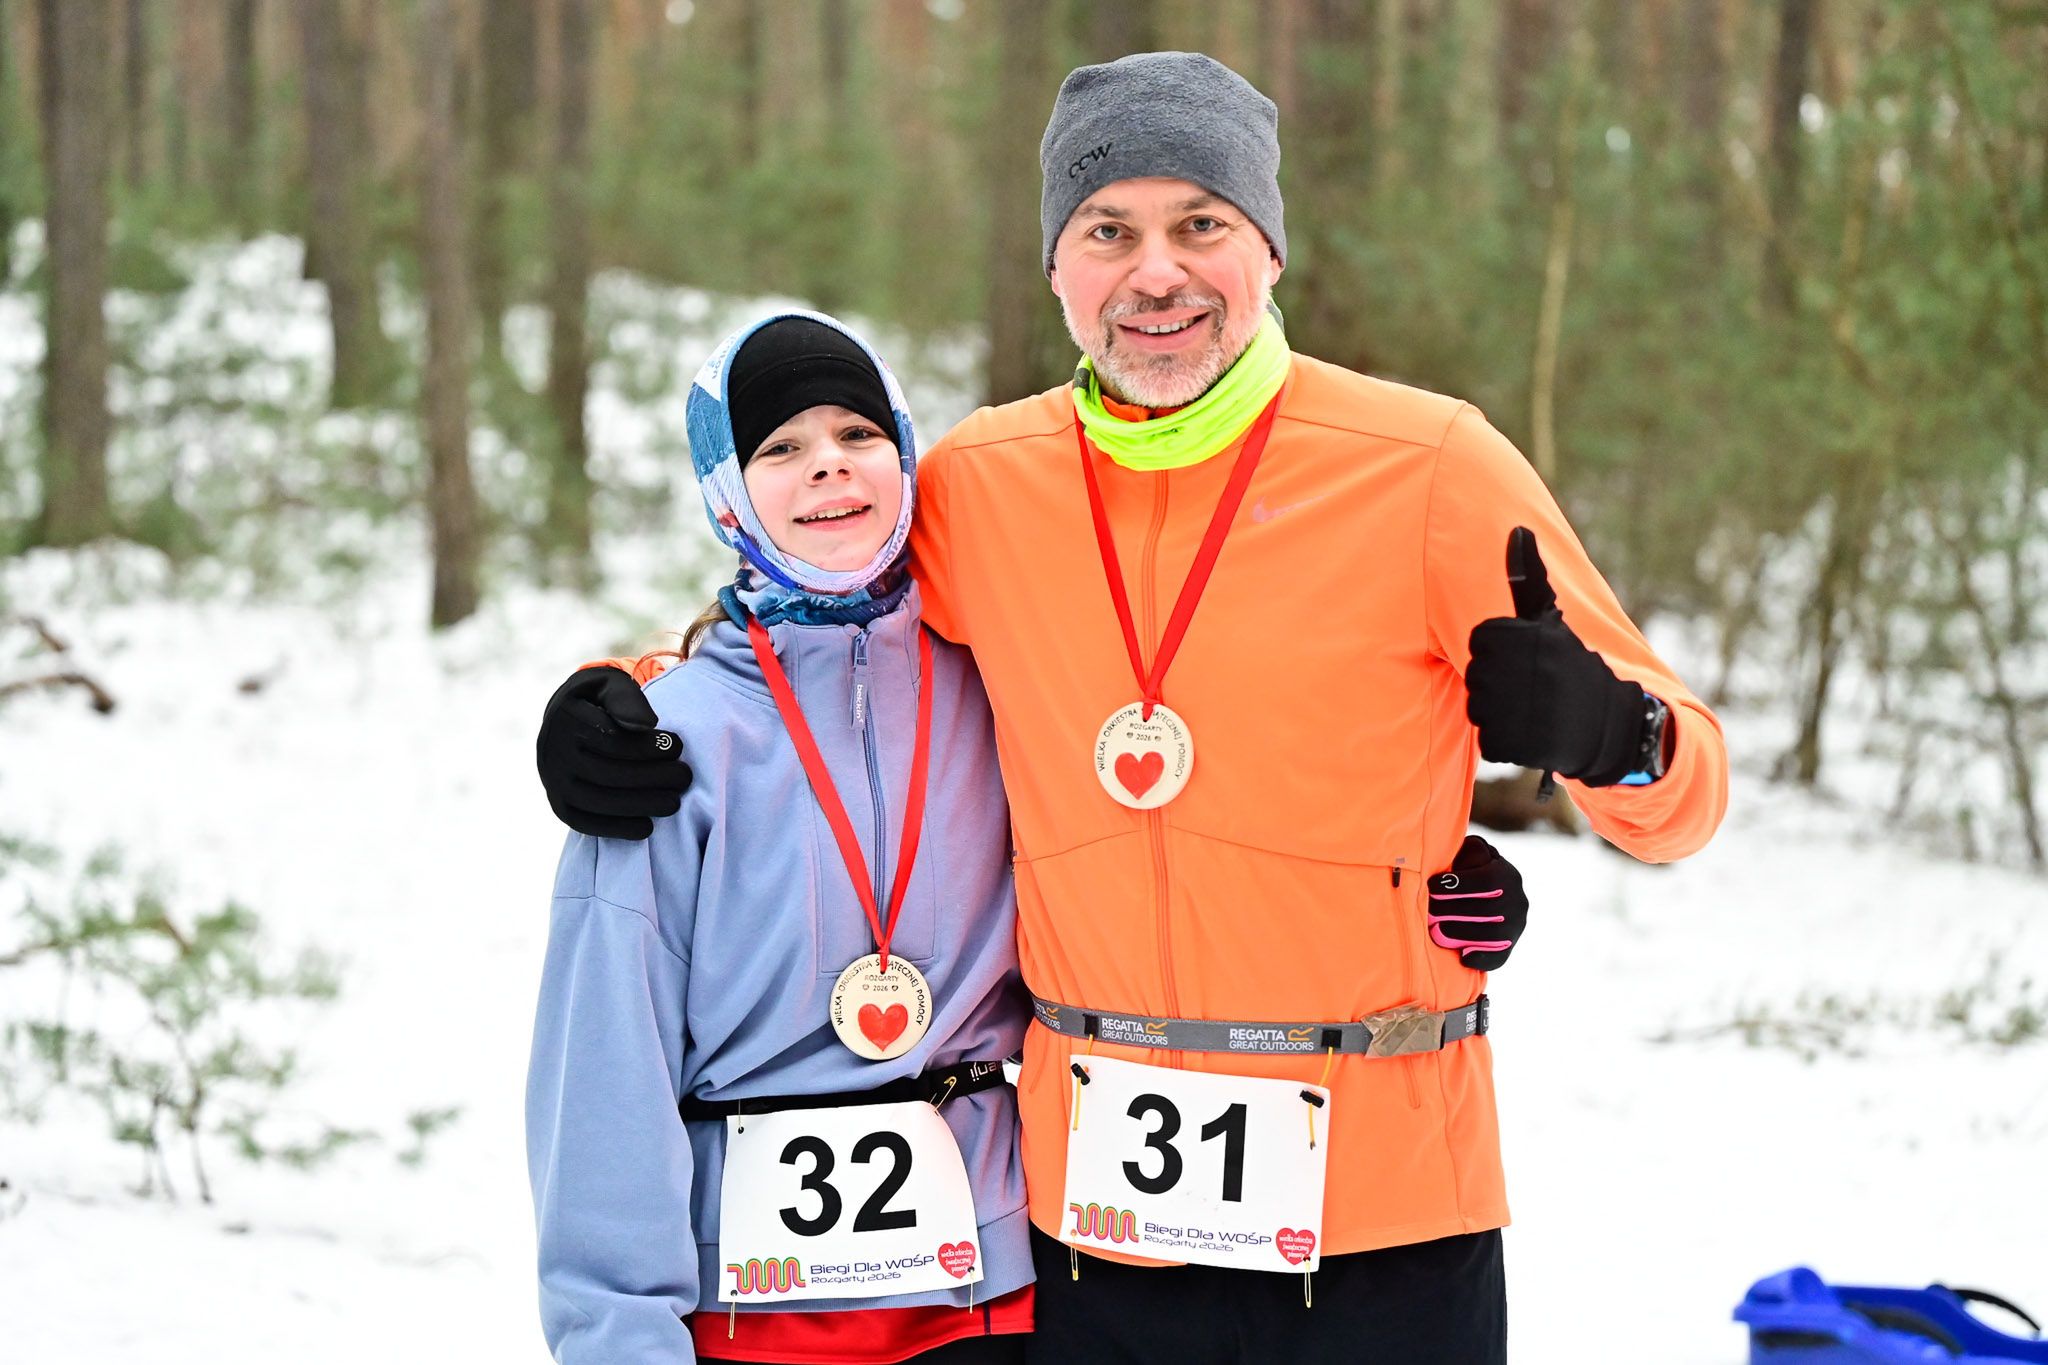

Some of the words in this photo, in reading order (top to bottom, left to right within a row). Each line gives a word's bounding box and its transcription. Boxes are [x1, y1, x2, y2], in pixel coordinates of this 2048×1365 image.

[1097, 741, 1107, 772] WIELKA
[1103, 708, 1138, 738] ORKIESTRA
[1174, 743, 1186, 779] POMOCY
[1136, 733, 1152, 741] 2026
[838, 960, 873, 992] ORKIESTRA
[834, 995, 844, 1026] WIELKA
[916, 988, 926, 1026] POMOCY
[1101, 1017, 1144, 1034] REGATTA
[1229, 1028, 1286, 1041] REGATTA
[1101, 1030, 1126, 1041] GREAT
[1125, 1032, 1168, 1046] OUTDOORS
[1229, 1040, 1259, 1050] GREAT
[1260, 1041, 1314, 1051] OUTDOORS
[1122, 1093, 1247, 1203] 31
[779, 1131, 917, 1237] 32
[1144, 1222, 1183, 1238] Biegi
[1187, 1228, 1214, 1240] Dla
[1218, 1232, 1272, 1245] WOŚP
[1144, 1234, 1197, 1249] Rozgarty
[1199, 1242, 1234, 1252] 2026
[810, 1263, 850, 1275] Biegi
[854, 1261, 881, 1273] Dla
[885, 1253, 935, 1270] WOŚP
[811, 1275, 865, 1284] Rozgarty
[868, 1272, 901, 1282] 2026
